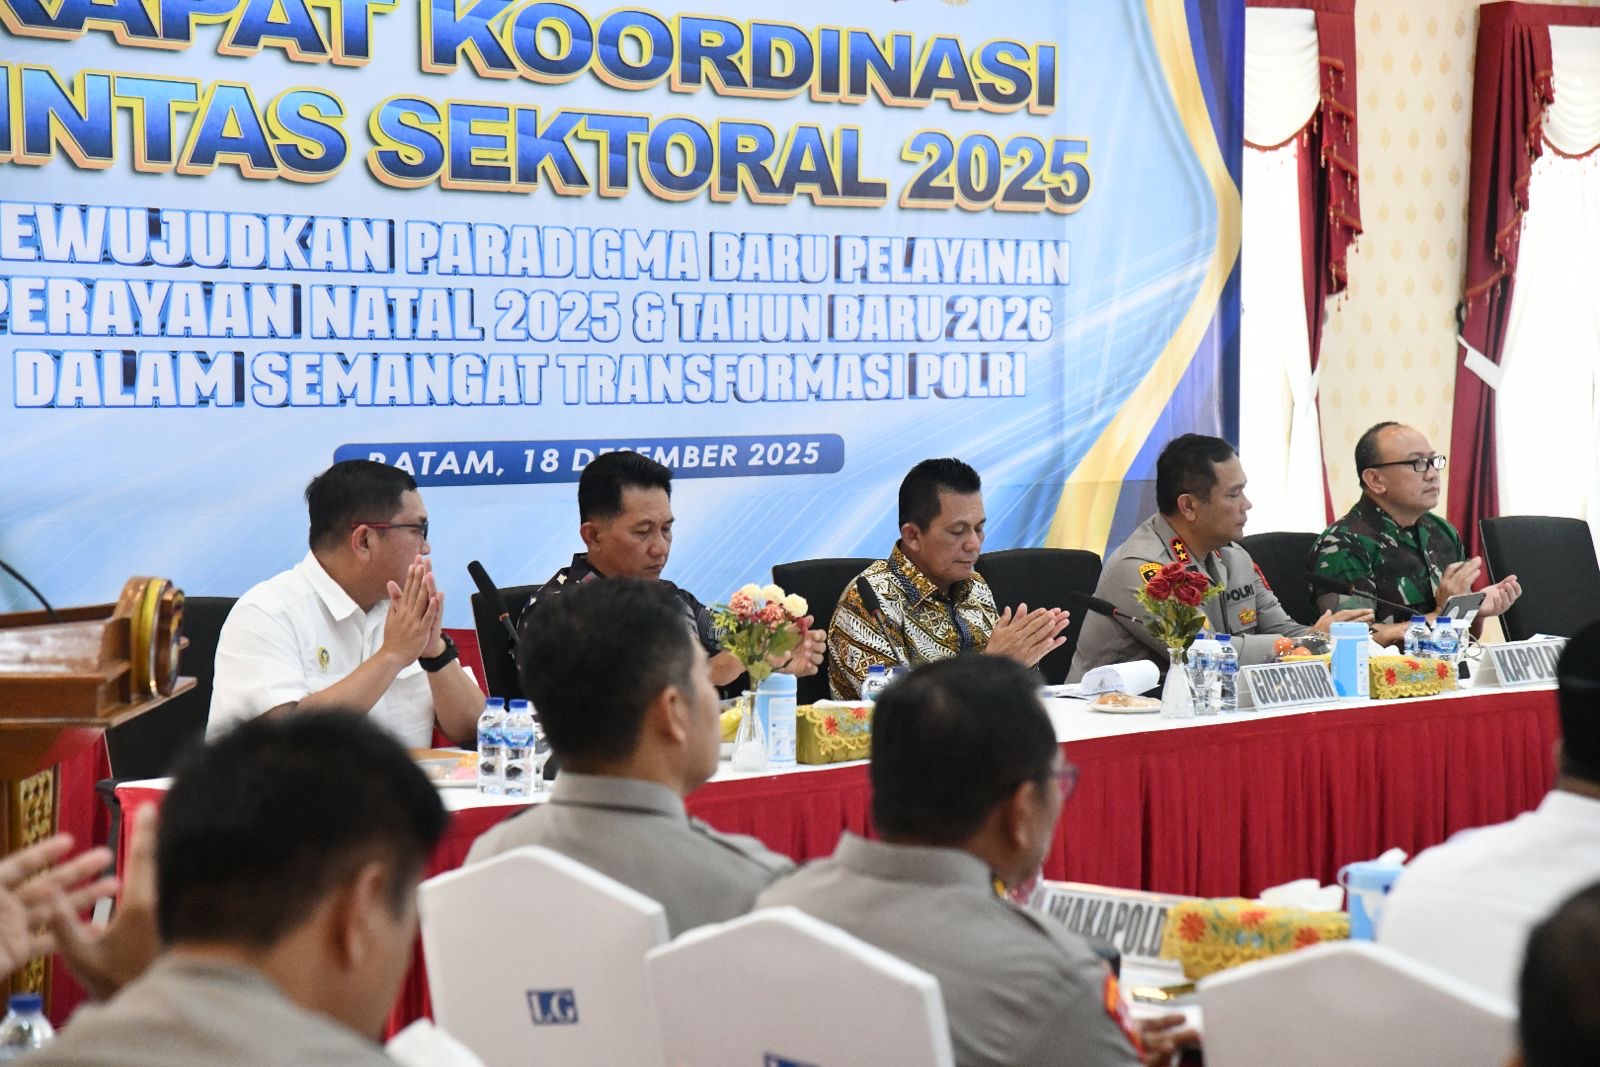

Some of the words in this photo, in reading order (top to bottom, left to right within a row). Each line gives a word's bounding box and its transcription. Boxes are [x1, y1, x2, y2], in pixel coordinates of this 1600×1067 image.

[421, 0, 1058, 115] KOORDINASI
[366, 94, 888, 207] SEKTORAL
[899, 130, 1093, 215] 2025
[405, 219, 700, 281] PARADIGMA
[708, 231, 829, 283] BARU
[834, 235, 1071, 286] PELAYANAN
[309, 284, 485, 342] NATAL
[493, 289, 621, 343] 2025
[632, 292, 666, 343] &
[672, 292, 821, 343] TAHUN
[828, 295, 943, 343] BARU
[945, 295, 1053, 342] 2026
[13, 349, 245, 408] DALAM
[250, 351, 549, 408] SEMANGAT
[556, 352, 905, 405] TRANSFORMASI
[909, 351, 1028, 400] POLRI
[523, 448, 560, 473] 18
[571, 443, 737, 472] DMBER
[748, 441, 820, 466] 2025
[1250, 664, 1335, 705] GUBERNUR
[1495, 644, 1563, 683] KAPOLD
